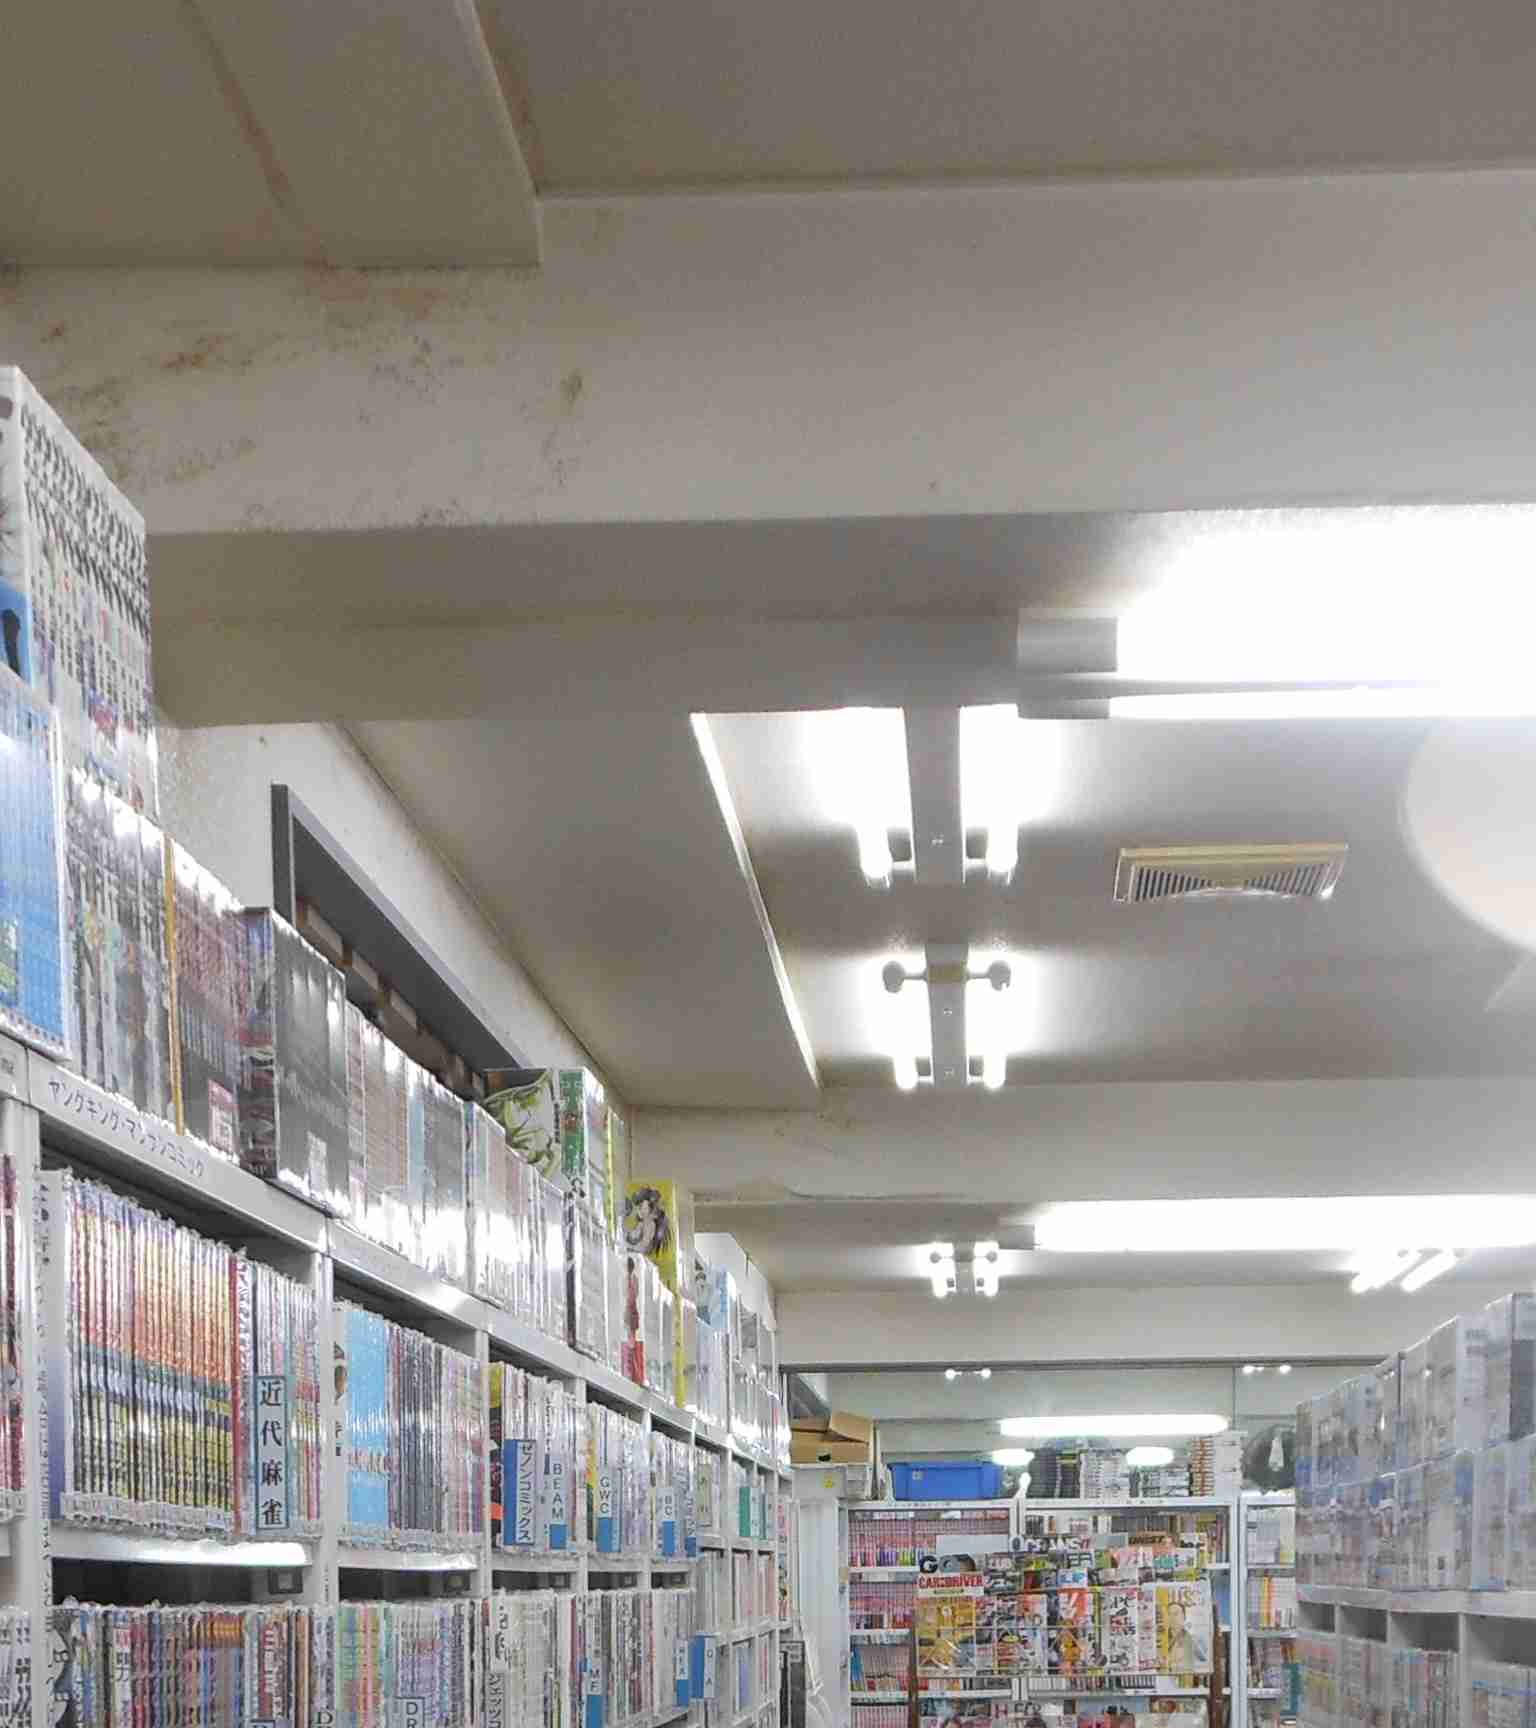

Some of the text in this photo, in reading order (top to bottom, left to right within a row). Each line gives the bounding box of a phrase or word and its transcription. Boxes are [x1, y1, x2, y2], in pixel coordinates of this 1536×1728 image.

[259, 1378, 284, 1526] 近代麻雀
[552, 1463, 563, 1519] BEAM
